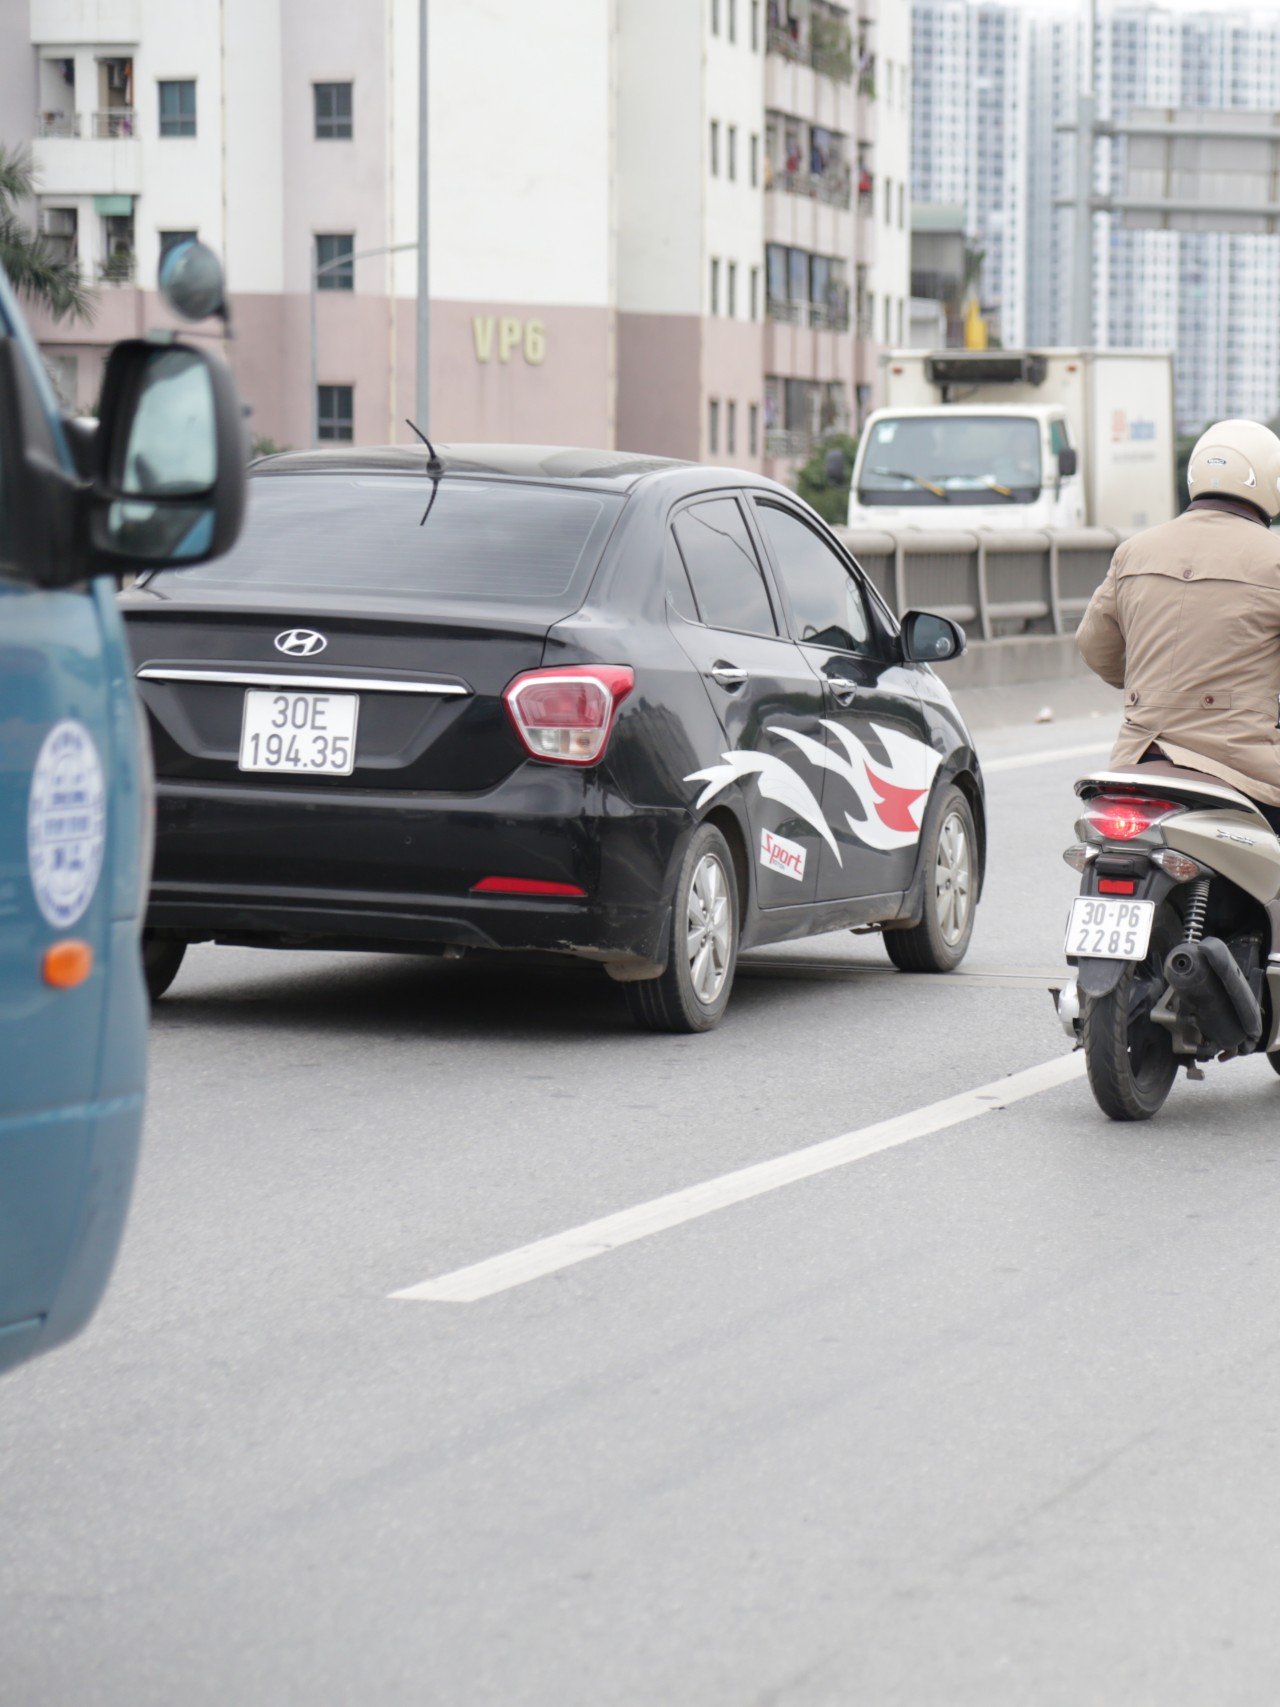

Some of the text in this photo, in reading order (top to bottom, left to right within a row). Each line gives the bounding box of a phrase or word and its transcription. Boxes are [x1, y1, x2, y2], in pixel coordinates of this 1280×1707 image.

[474, 315, 546, 363] VP6
[271, 695, 330, 731] 30E
[250, 732, 350, 769] 194.35
[761, 833, 803, 876] Sport
[1076, 928, 1138, 955] 2285
